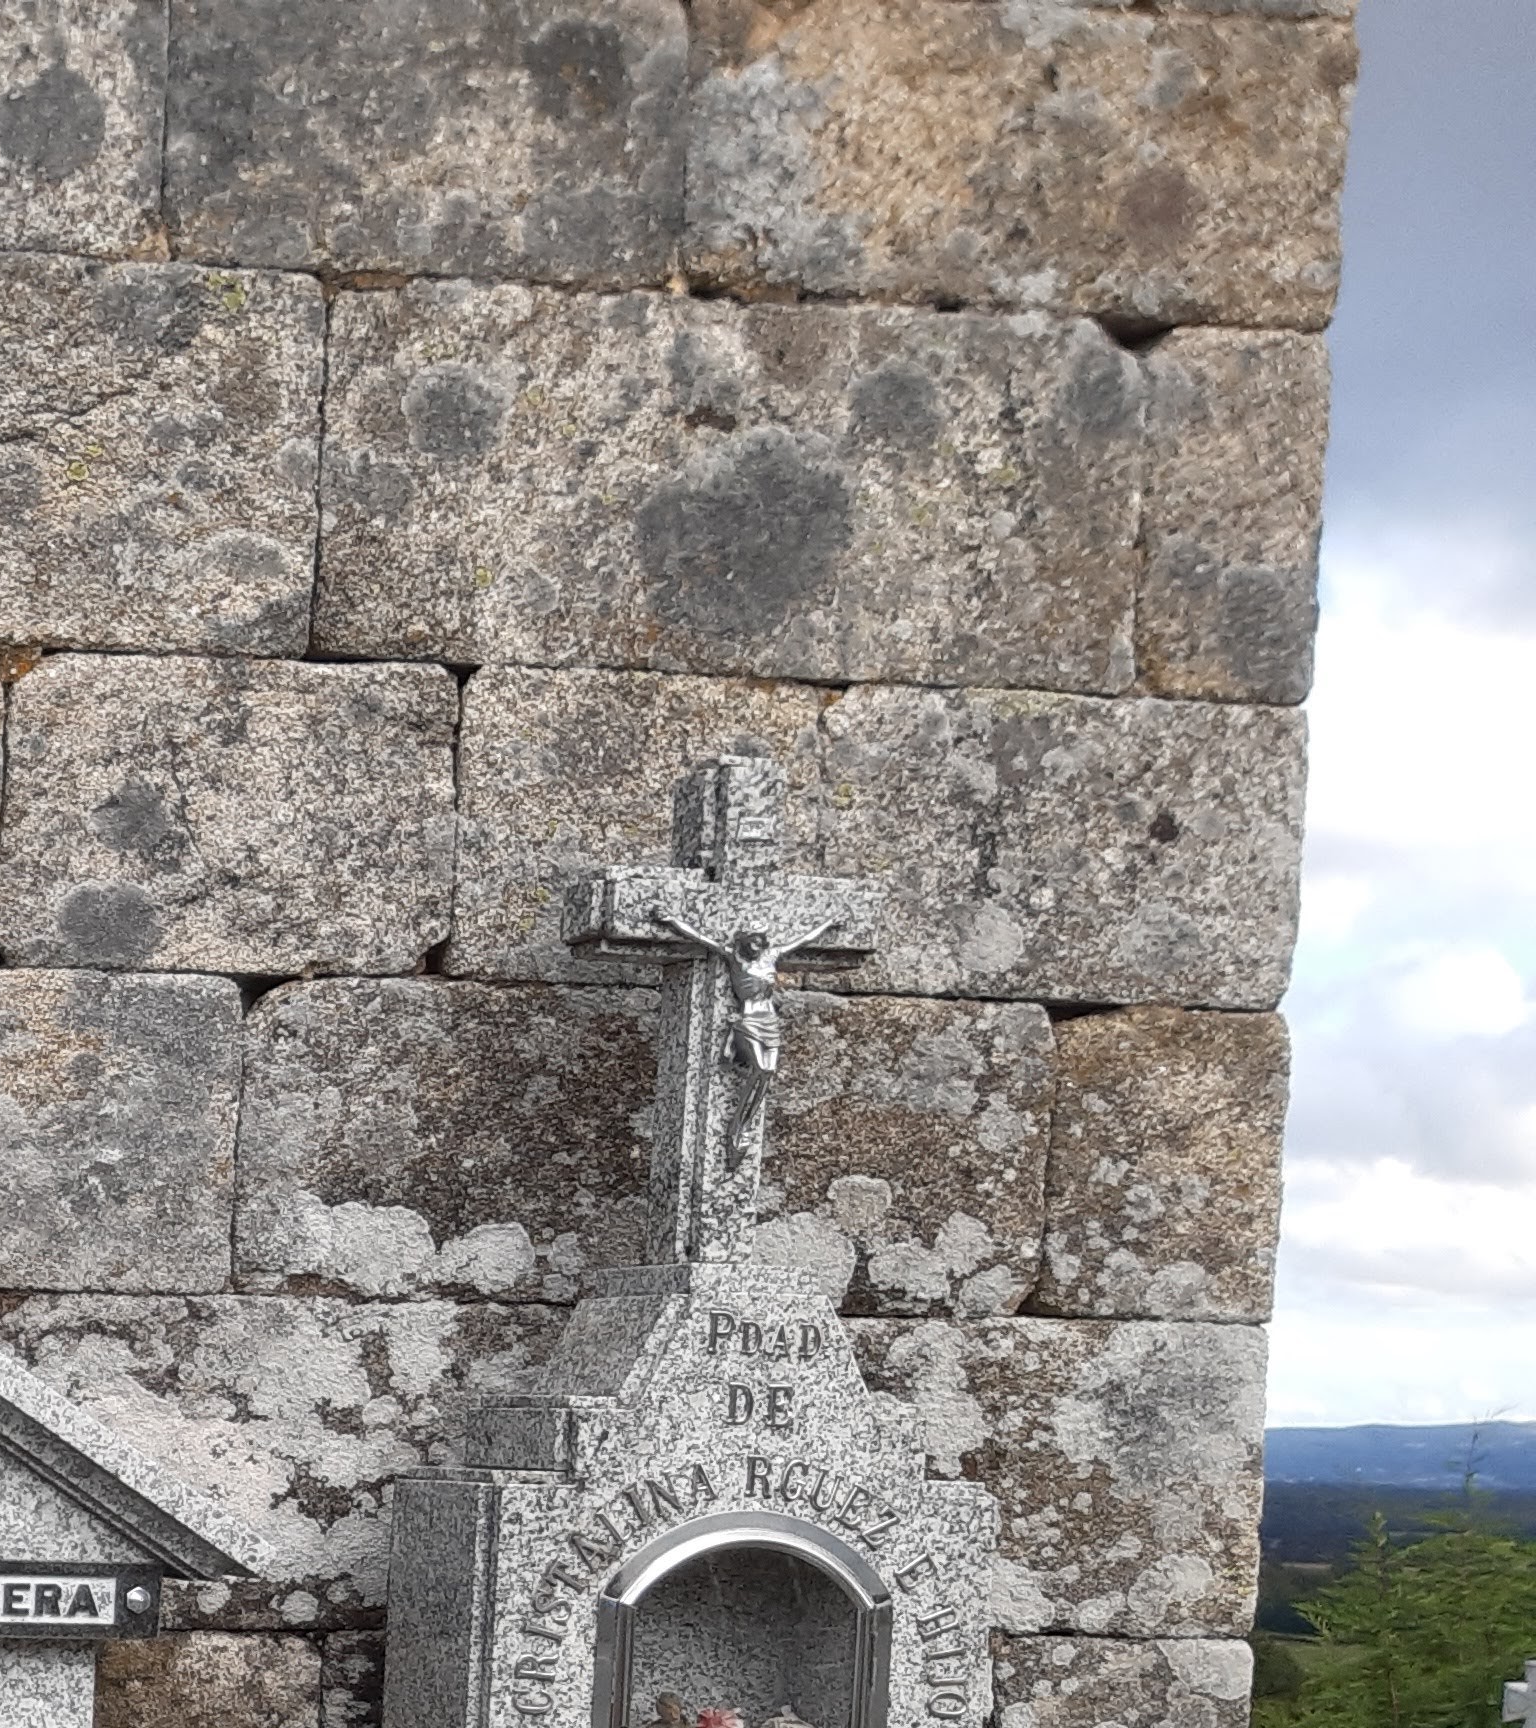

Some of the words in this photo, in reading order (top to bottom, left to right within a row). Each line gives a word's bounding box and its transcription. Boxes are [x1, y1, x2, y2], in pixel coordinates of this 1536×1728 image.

[726, 1381, 794, 1426] DE
[745, 1454, 901, 1550] RGUEZ
[513, 1462, 716, 1715] CRISTALINA
[894, 1550, 940, 1593] E
[916, 1605, 968, 1720] HIJO
